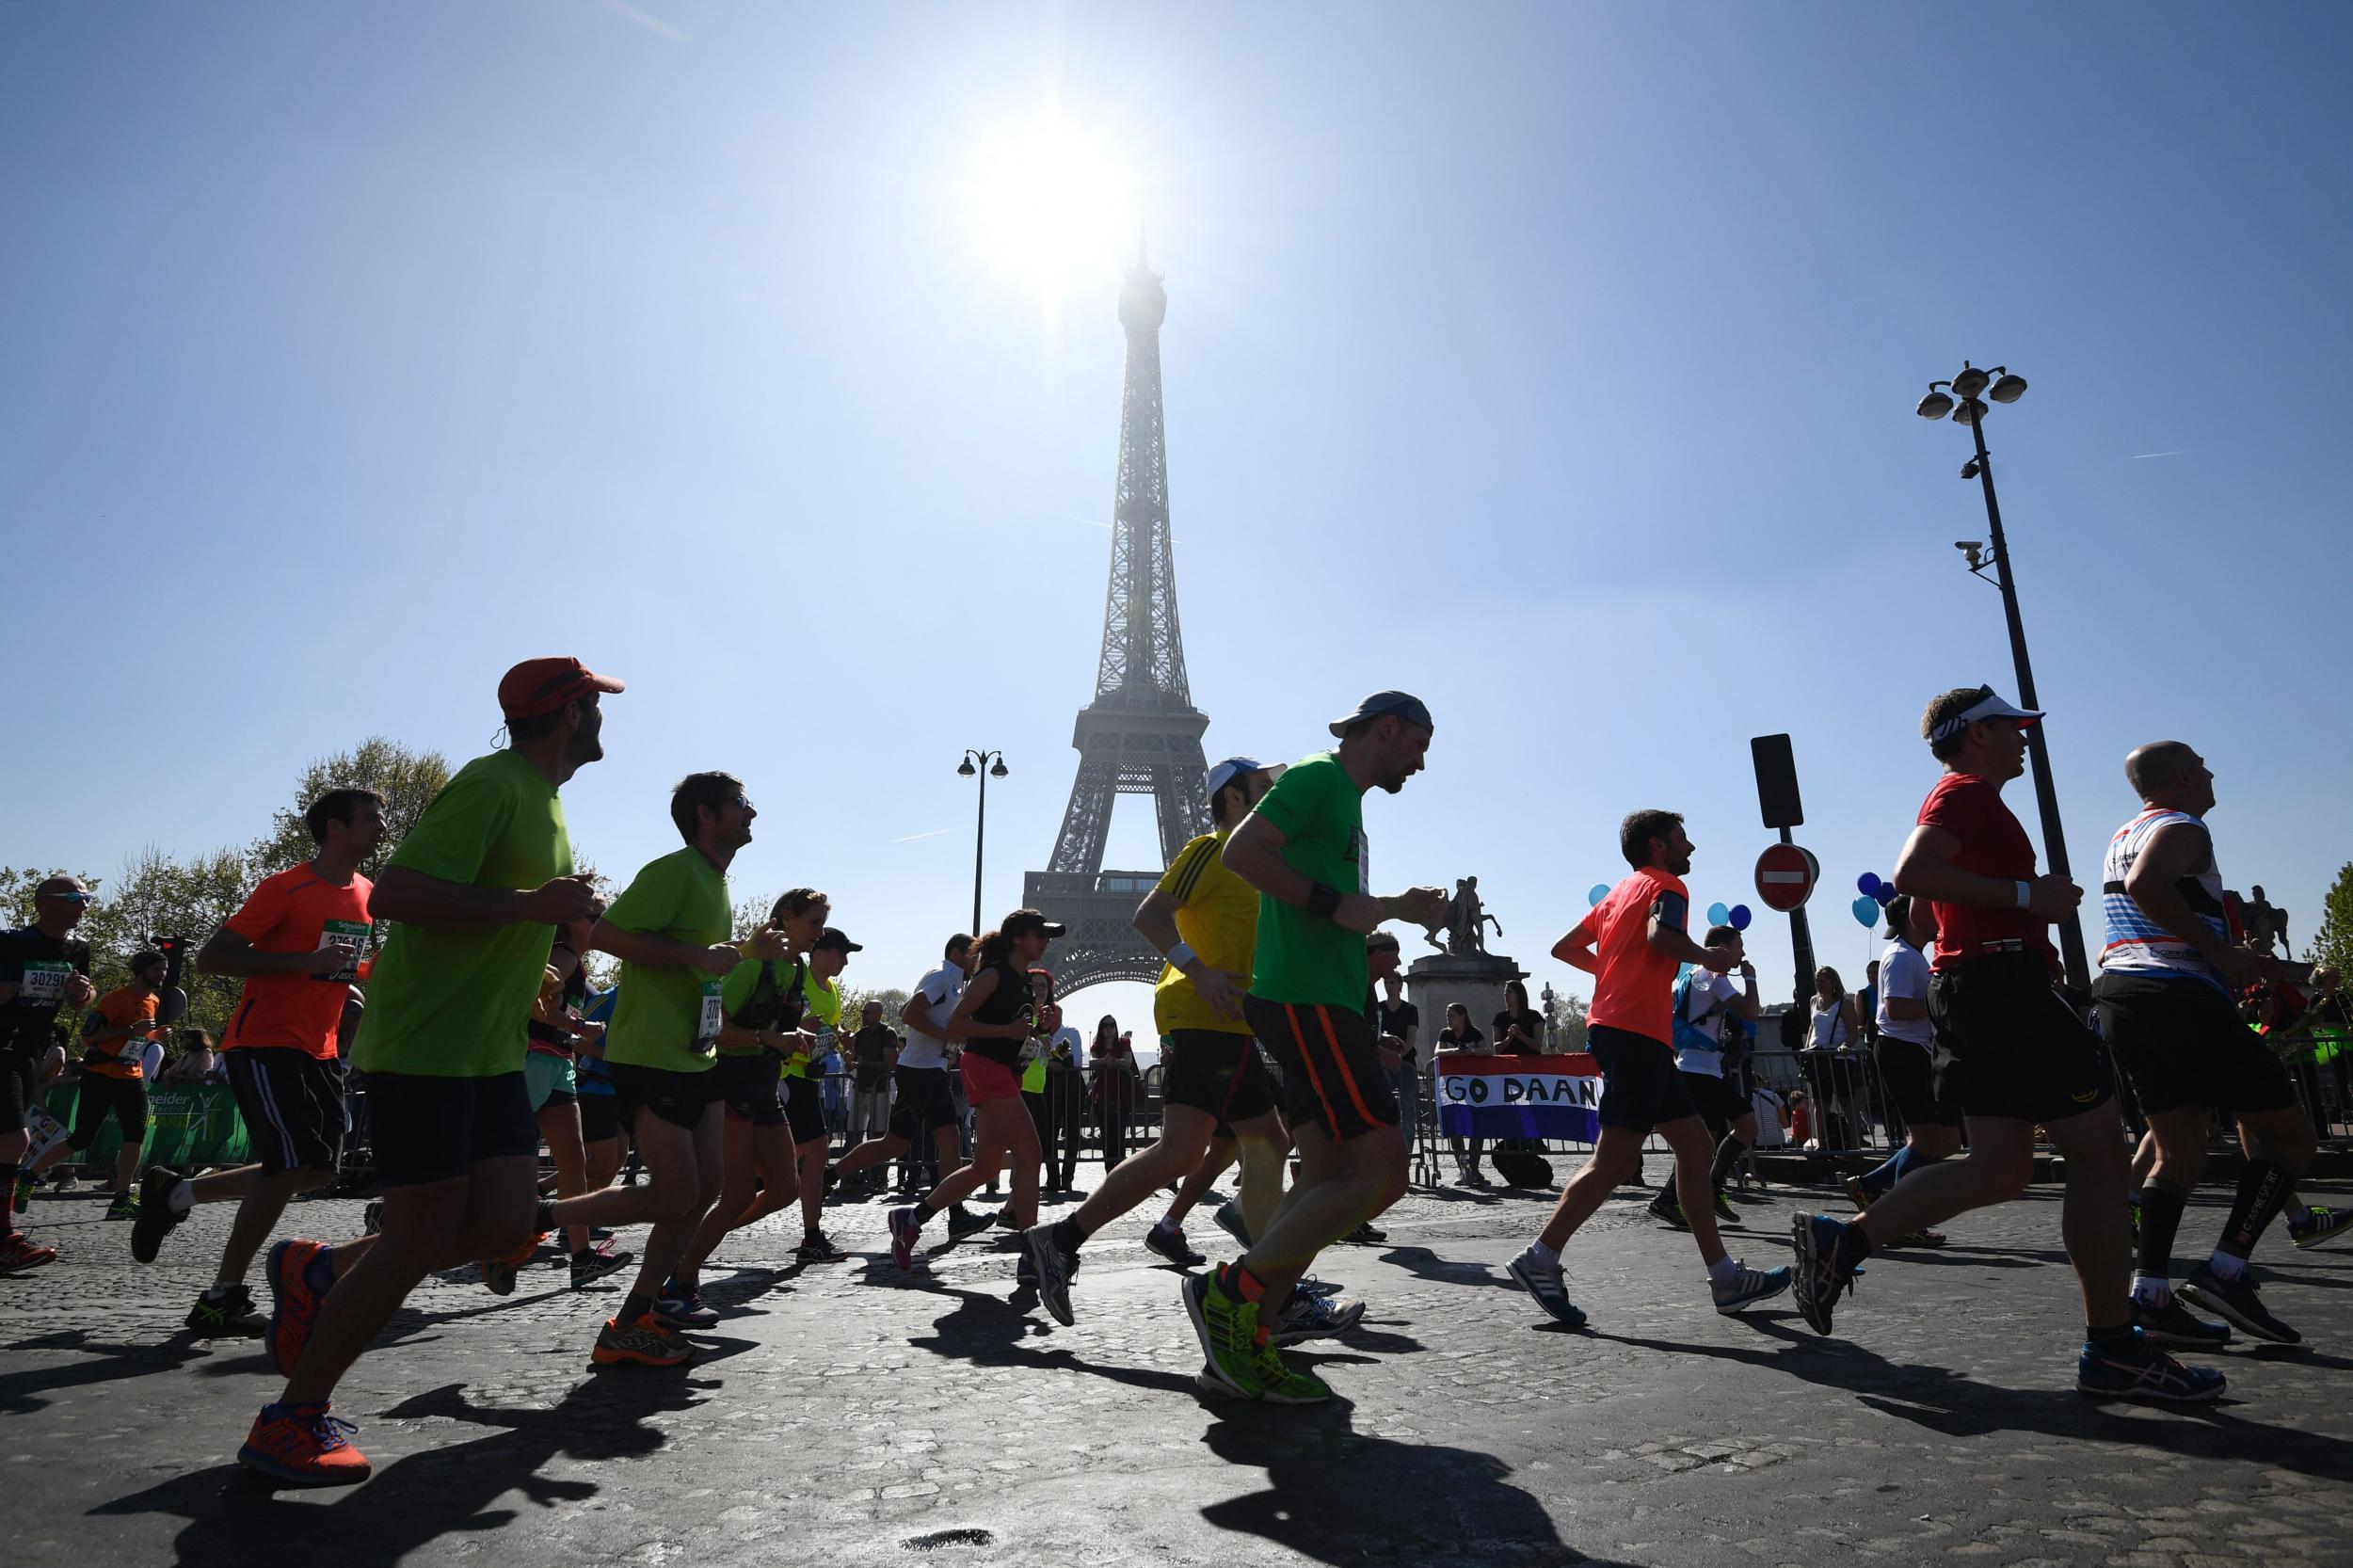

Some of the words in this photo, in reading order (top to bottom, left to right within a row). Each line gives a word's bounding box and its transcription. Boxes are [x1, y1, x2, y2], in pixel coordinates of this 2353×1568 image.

[30, 971, 65, 987] 30291
[147, 1092, 190, 1105] neider
[1445, 1076, 1489, 1104] GO
[1503, 1077, 1597, 1107] DAAN
